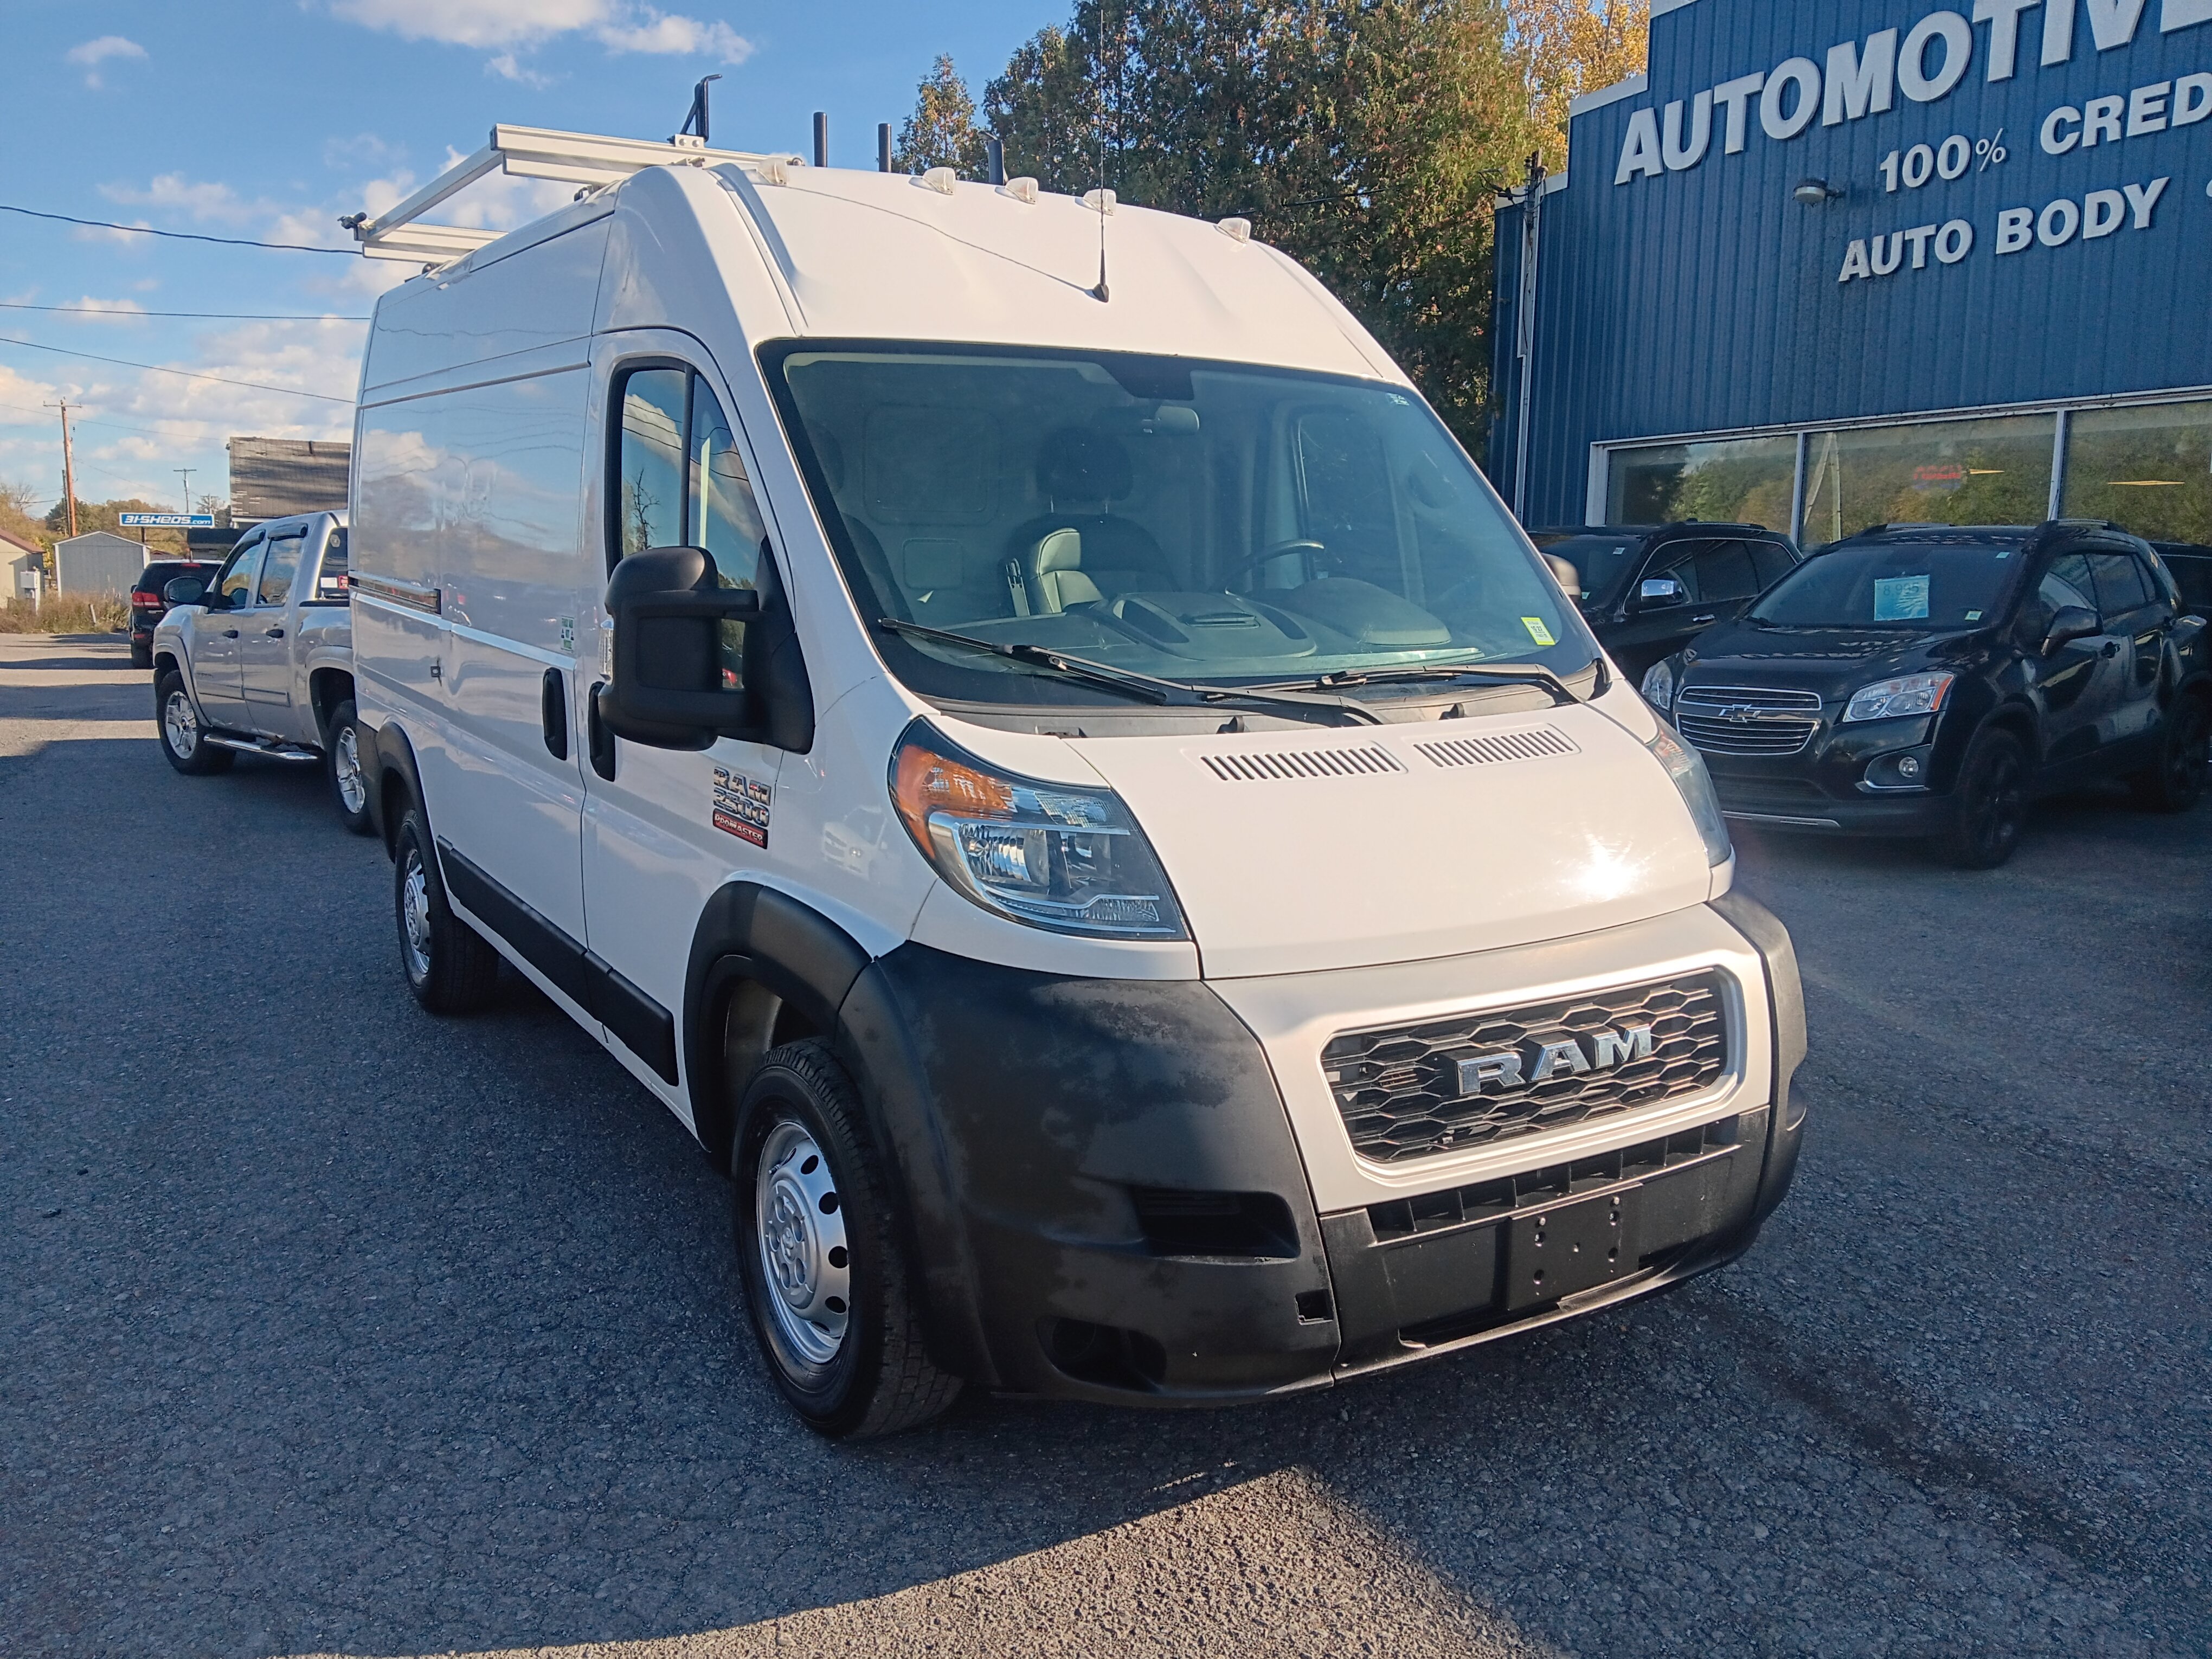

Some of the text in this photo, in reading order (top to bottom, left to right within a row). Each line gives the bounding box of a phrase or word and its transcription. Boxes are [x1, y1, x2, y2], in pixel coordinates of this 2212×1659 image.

[1880, 72, 2212, 192] 100% CRED
[1838, 177, 2170, 282] AUTO BODY
[713, 766, 771, 806] RAM
[713, 787, 770, 827] 2500
[1457, 1023, 1652, 1096] RAM
